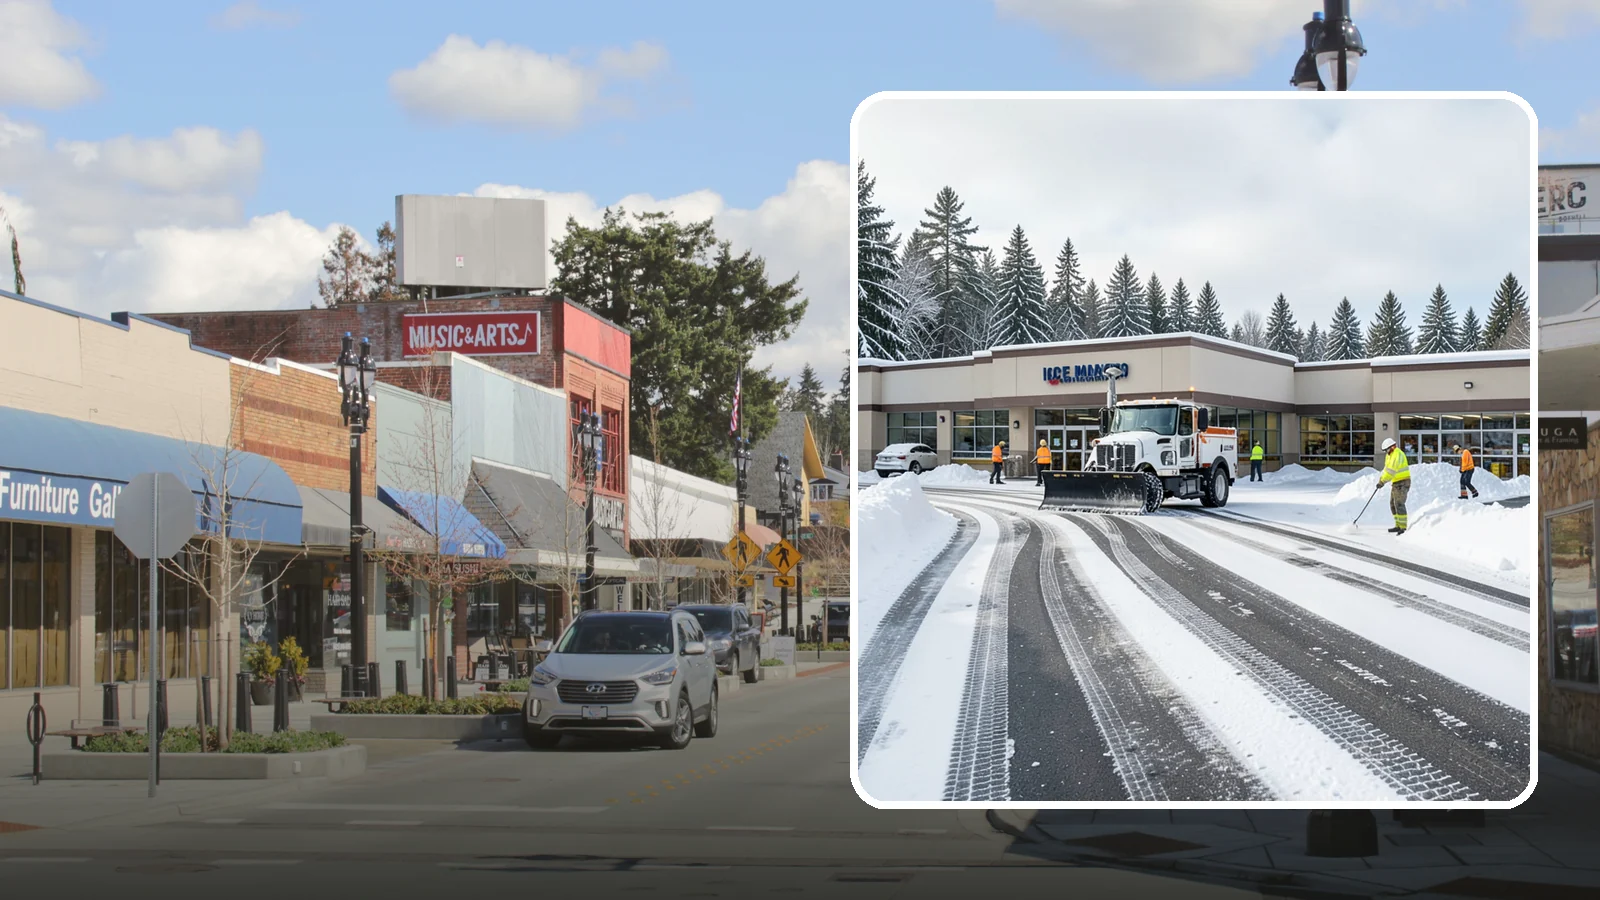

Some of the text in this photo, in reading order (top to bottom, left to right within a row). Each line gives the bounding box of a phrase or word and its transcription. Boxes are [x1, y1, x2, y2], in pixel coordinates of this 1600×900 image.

[409, 323, 520, 349] MUSIC&ARTS
[0, 471, 79, 515] Furniture
[453, 563, 479, 574] SUSHI
